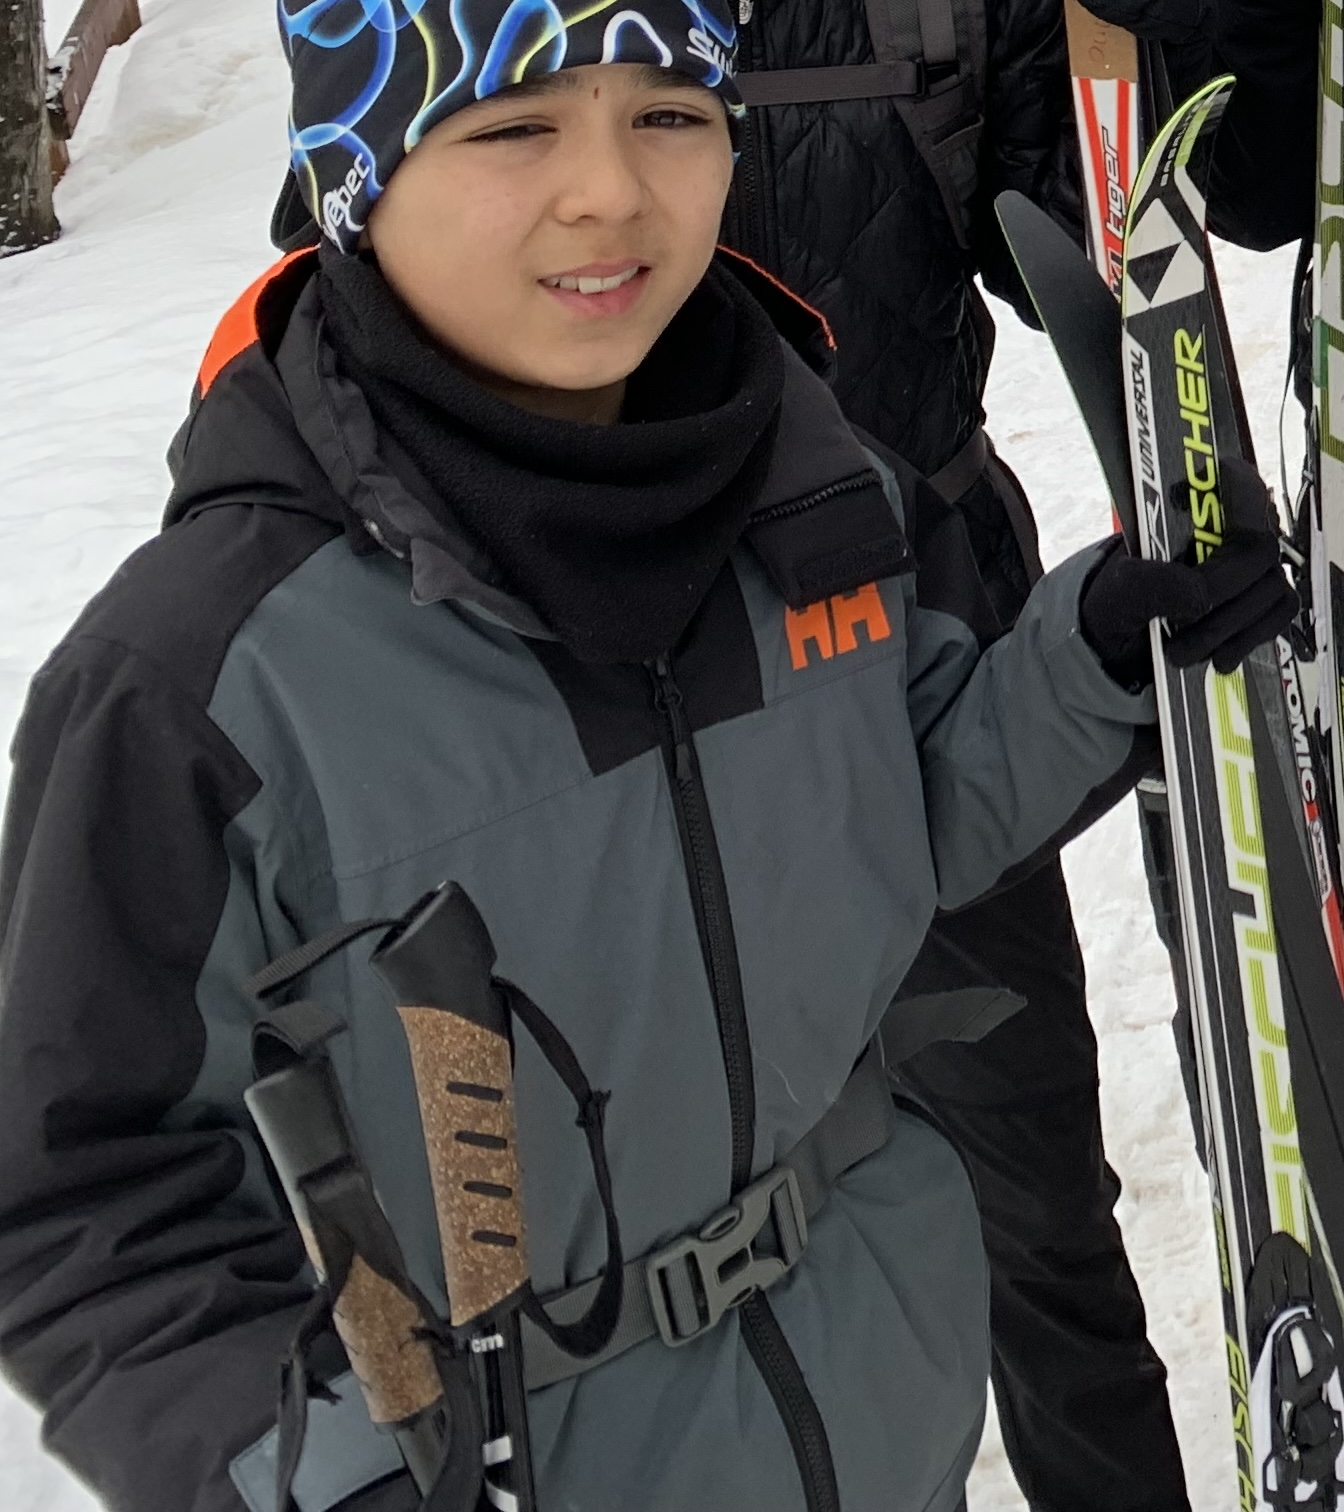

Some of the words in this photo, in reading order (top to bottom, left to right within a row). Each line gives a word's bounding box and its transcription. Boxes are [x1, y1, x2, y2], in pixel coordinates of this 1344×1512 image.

[1131, 349, 1155, 481] UNIVERSAL
[783, 579, 891, 671] HH
[1275, 635, 1317, 804] ATOMIC
